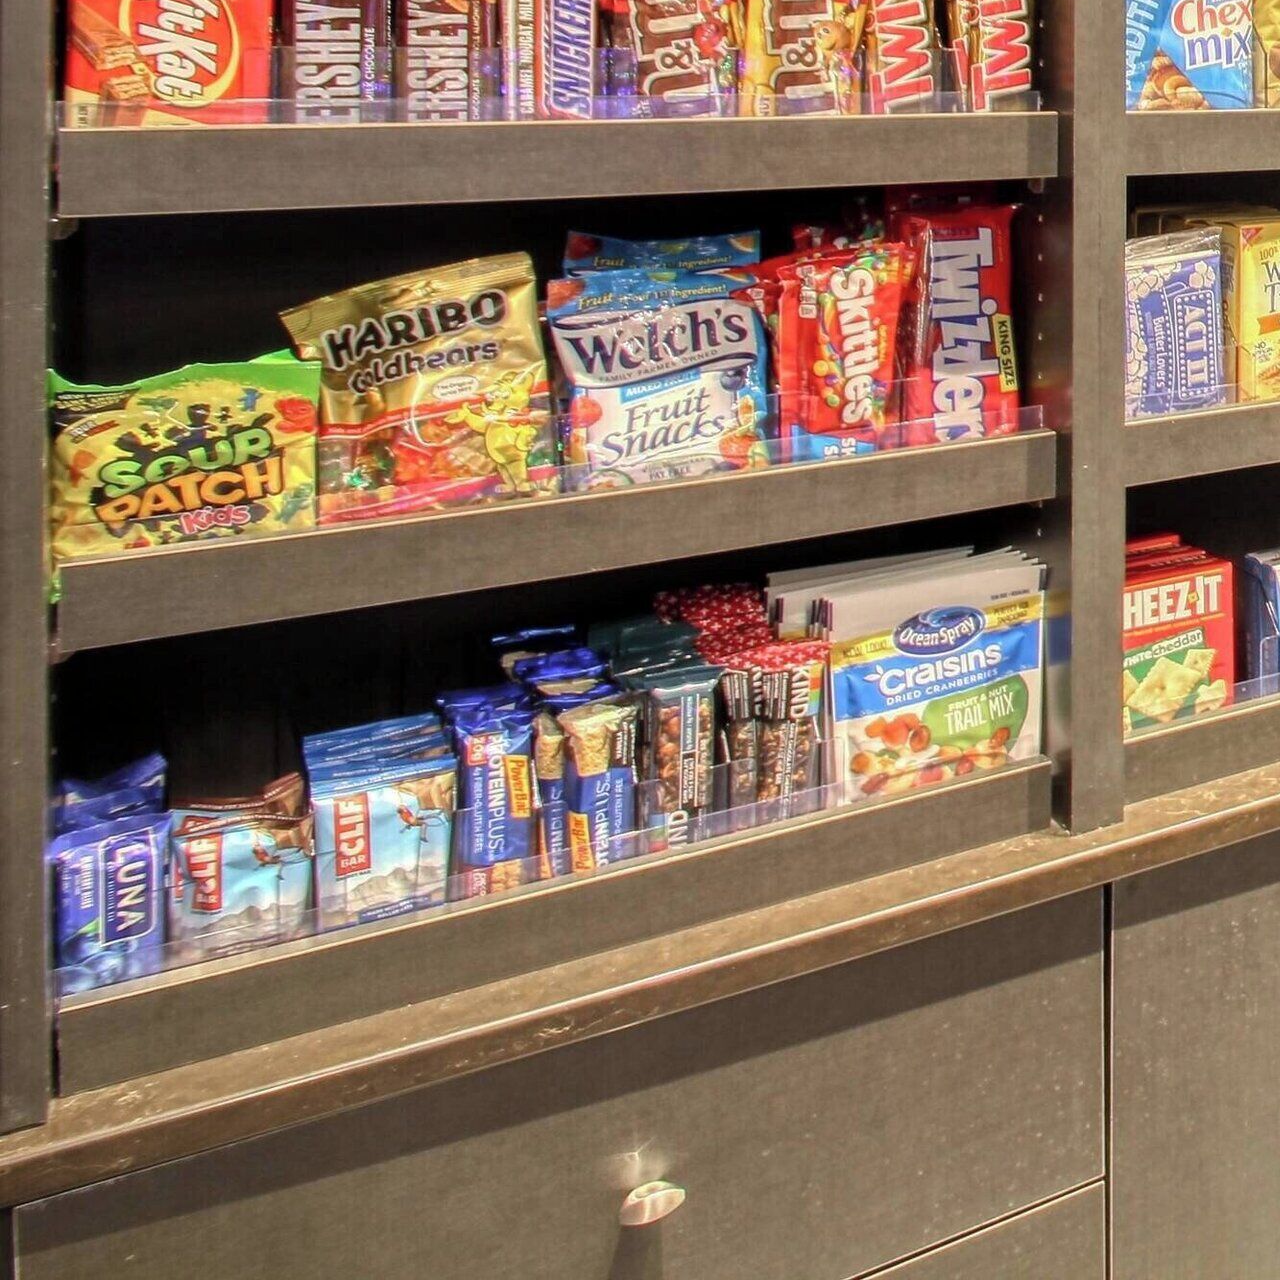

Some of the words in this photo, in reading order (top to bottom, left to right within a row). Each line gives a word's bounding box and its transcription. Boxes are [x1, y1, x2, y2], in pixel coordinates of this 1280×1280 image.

[138, 23, 218, 99] Kat
[364, 26, 376, 80] CHOCOLATE
[1185, 28, 1252, 71] mix
[577, 293, 614, 310] Fruit
[670, 285, 728, 300] Ingredient!
[323, 289, 508, 373] HARIBO
[564, 307, 749, 375] Welch's
[830, 267, 880, 425] Skittles
[997, 319, 1012, 356] KING
[1152, 316, 1166, 351] Butter
[1183, 304, 1207, 352] ACT
[348, 339, 501, 396] Goldbears
[680, 349, 718, 364] OWNED
[1000, 357, 1014, 387] SIZE
[1155, 351, 1167, 388] Lovers
[1187, 355, 1208, 387] II
[624, 384, 712, 434] Fruit
[601, 409, 727, 468] Snacks
[100, 425, 274, 499] SOUR
[96, 448, 285, 532] PATCH
[179, 503, 252, 536] Kids
[898, 628, 940, 649] Ocean
[939, 615, 979, 646] Spray
[1151, 629, 1204, 658] cheddar
[790, 665, 809, 719] KIND
[885, 689, 922, 708] DRIED
[925, 667, 999, 697] CRANBERRIES
[947, 694, 980, 712] FRUIT
[988, 684, 1009, 700] NUT
[943, 706, 988, 736] TRAIL
[988, 690, 1015, 719] MIX
[471, 736, 485, 761] 20g
[510, 758, 527, 815] PowerBar
[338, 801, 368, 854] CLIF
[339, 854, 368, 868] BAR
[114, 841, 149, 932] LUNA
